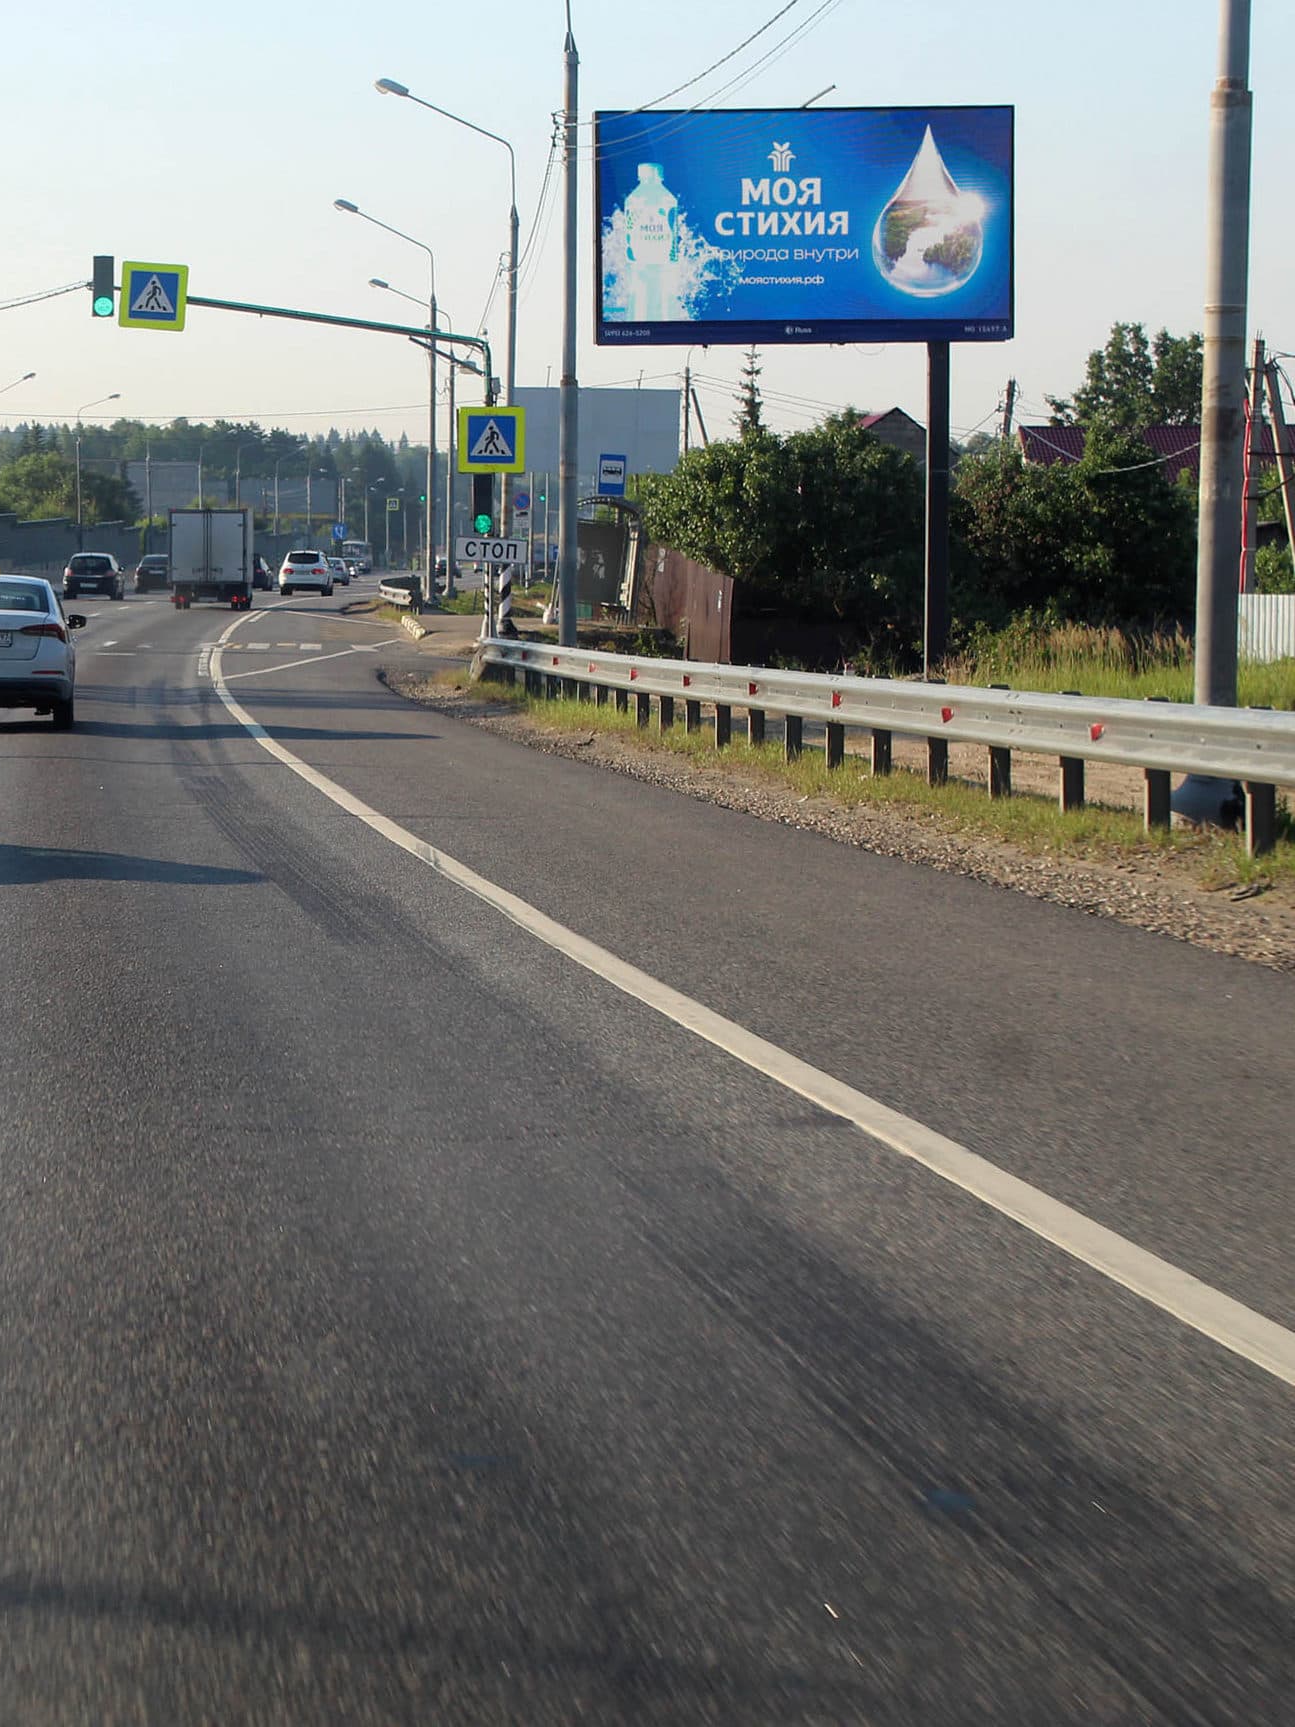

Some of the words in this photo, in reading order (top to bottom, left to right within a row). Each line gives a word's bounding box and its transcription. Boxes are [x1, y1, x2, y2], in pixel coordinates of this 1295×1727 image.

[741, 177, 822, 206] МОЯ
[714, 210, 849, 236] СТИХИЯ
[707, 248, 789, 263] рирода
[793, 248, 859, 263] внутри
[465, 541, 518, 560] СТОП
